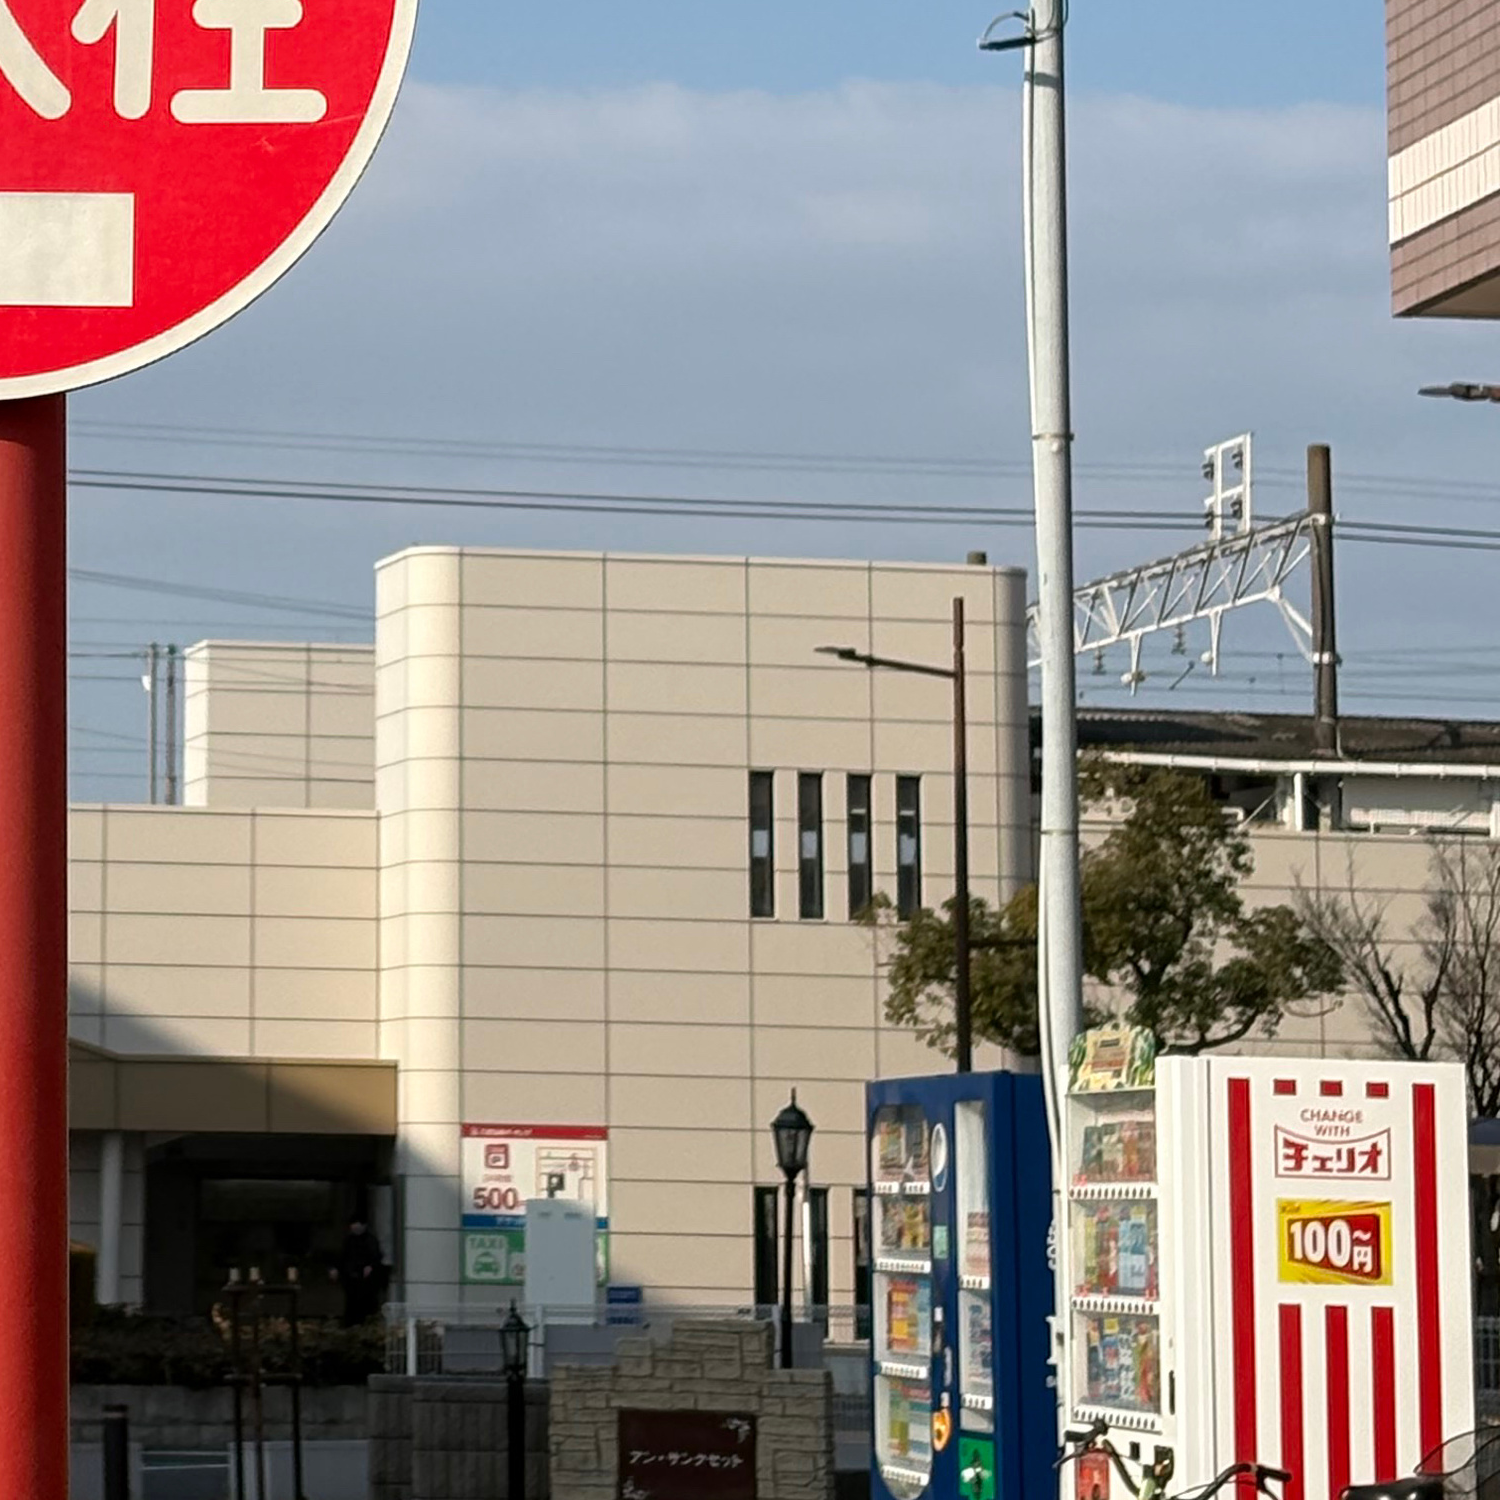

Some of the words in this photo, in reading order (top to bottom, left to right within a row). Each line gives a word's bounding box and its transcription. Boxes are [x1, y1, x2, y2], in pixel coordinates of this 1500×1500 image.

[1300, 1108, 1364, 1123] CHANGE
[1314, 1125, 1351, 1137] WITH
[1283, 1137, 1382, 1174] チェリオ
[473, 1187, 519, 1210] 500
[469, 1238, 507, 1249] TAXI
